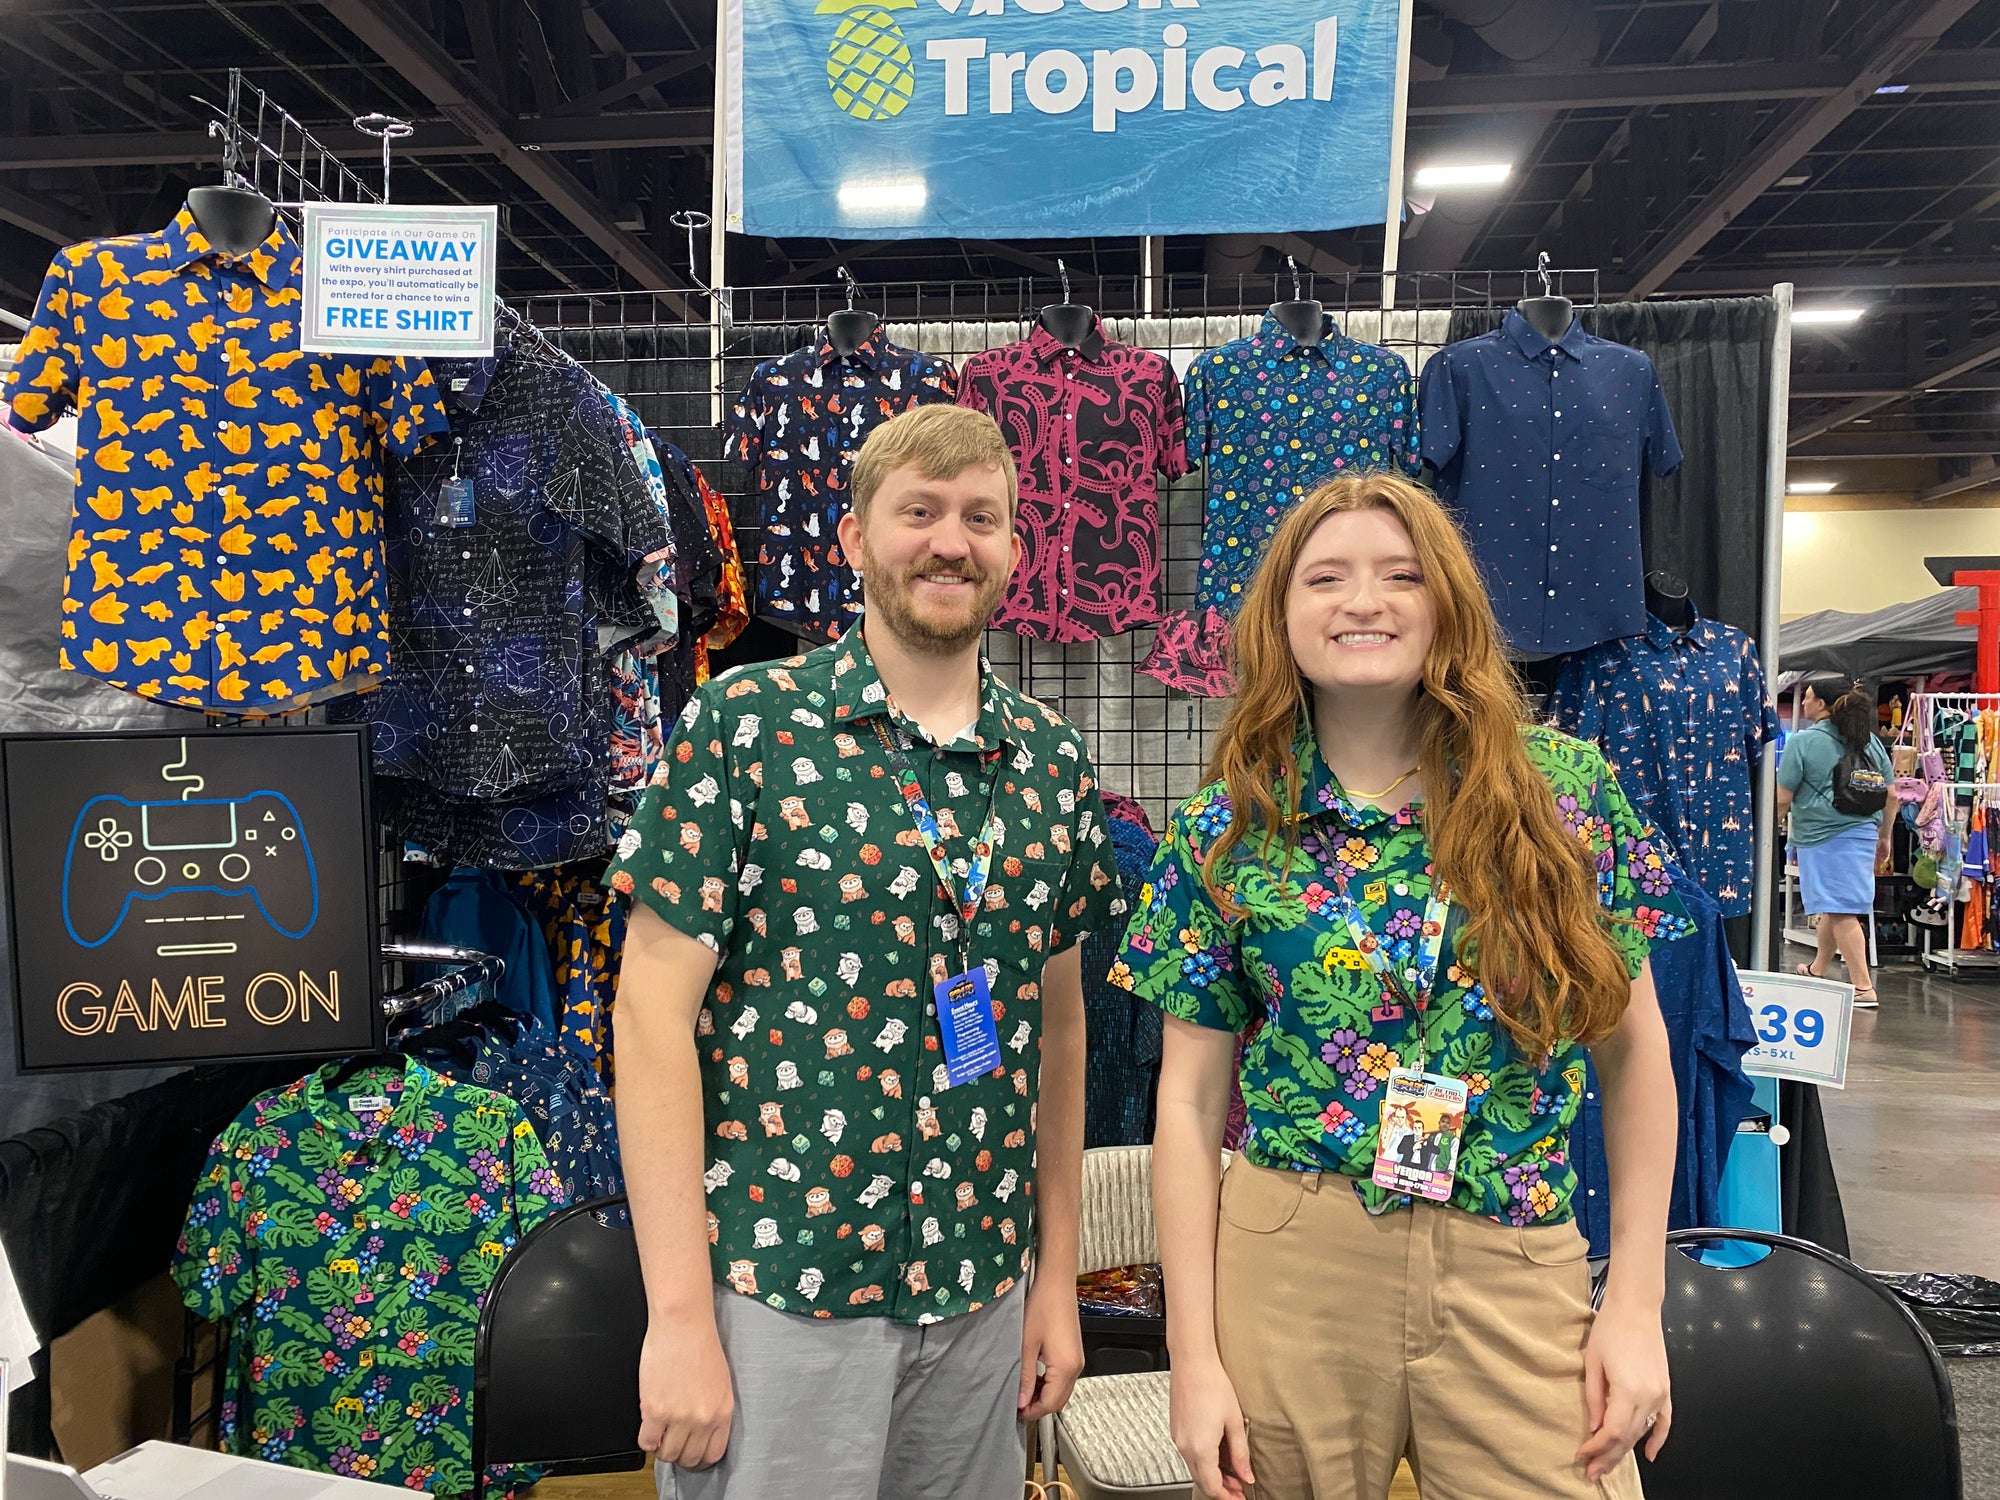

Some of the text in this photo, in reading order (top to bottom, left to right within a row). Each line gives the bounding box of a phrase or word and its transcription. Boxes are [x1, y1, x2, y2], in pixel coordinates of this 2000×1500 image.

[925, 15, 1338, 132] Tropical
[328, 227, 476, 239] Participate in Our Game On
[326, 238, 477, 262] GIVEAWAY
[329, 264, 472, 277] With every shirt purchased at
[322, 277, 479, 291] the expo, you'll automatically be
[330, 291, 369, 300] entered
[370, 291, 385, 301] for
[394, 292, 431, 302] chance
[433, 293, 443, 302] to
[444, 294, 462, 302] win
[326, 306, 473, 331] FREE SHIRT
[1740, 986, 1754, 998] 2
[56, 970, 340, 1036] GAME ON
[1746, 1004, 1825, 1048] 39
